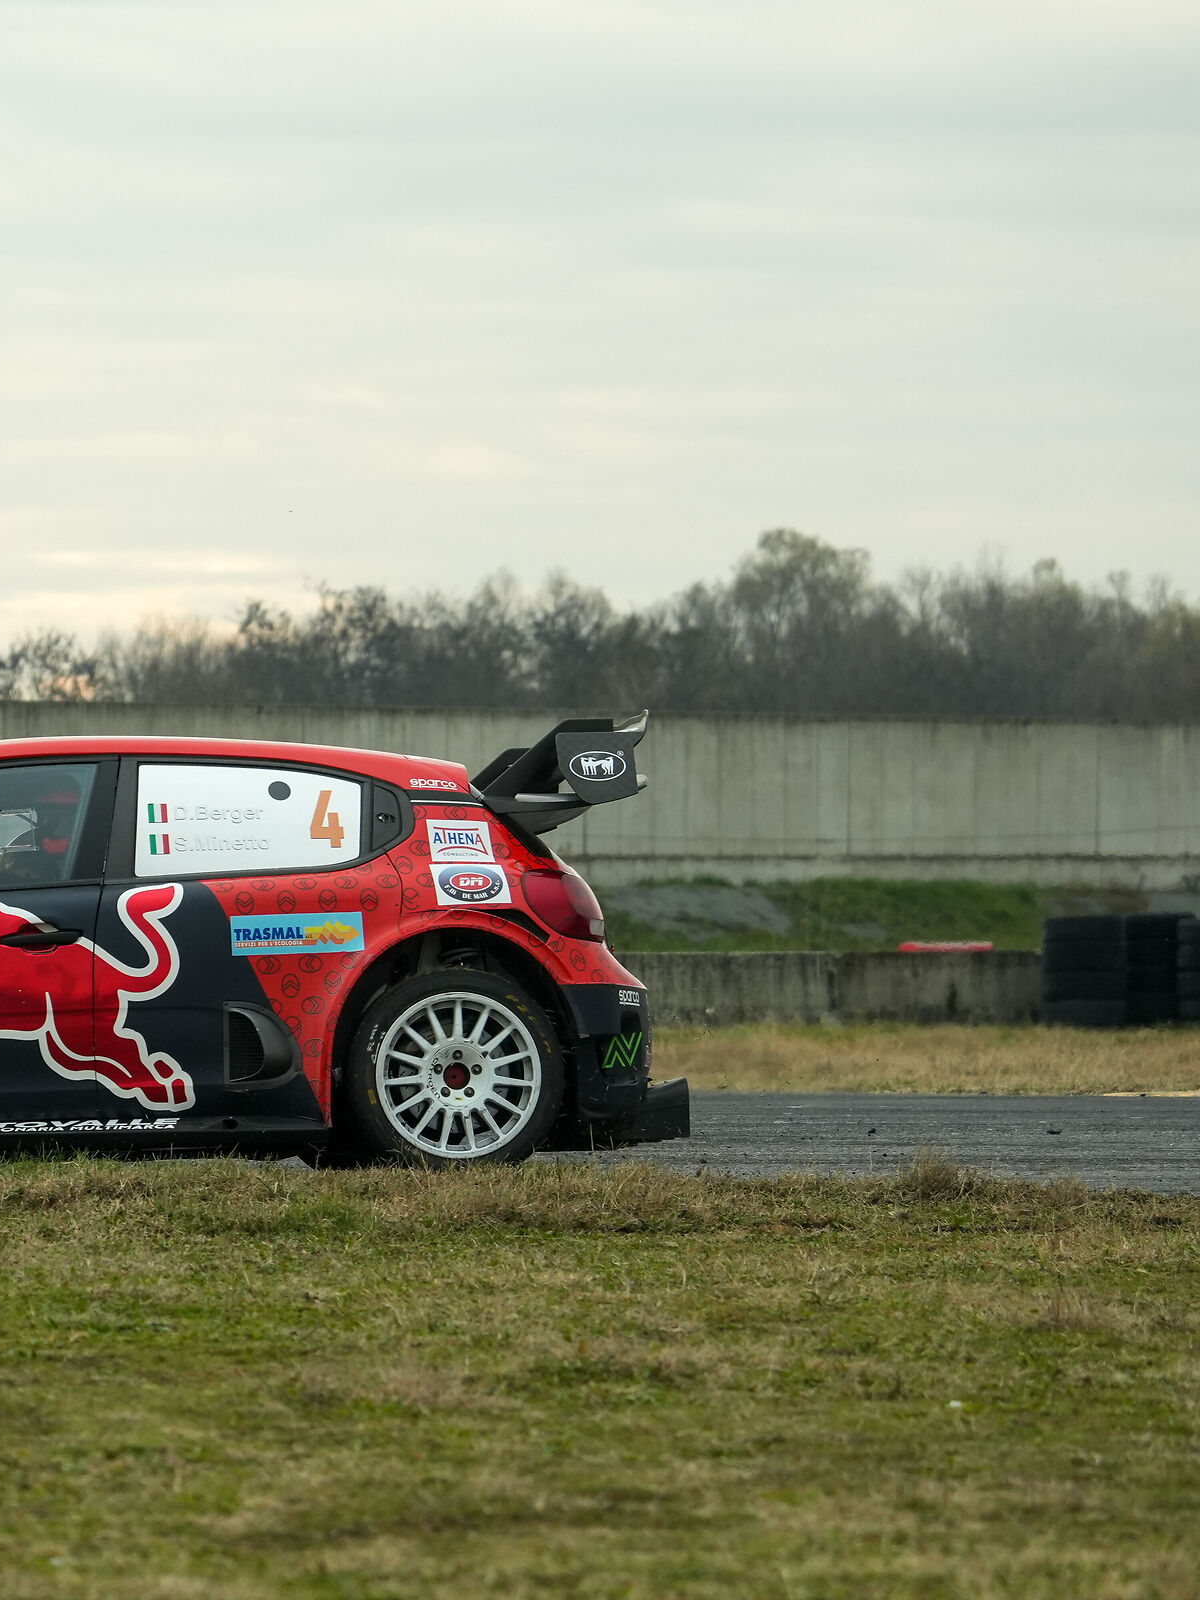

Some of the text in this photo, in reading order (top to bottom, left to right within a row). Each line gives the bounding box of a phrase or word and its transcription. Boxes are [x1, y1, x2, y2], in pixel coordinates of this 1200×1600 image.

[409, 778, 457, 790] sparco
[174, 806, 264, 824] D.Berger
[310, 790, 344, 848] 4
[174, 836, 270, 852] S.Minetto
[433, 827, 485, 846] ATHENA
[459, 877, 484, 886] DM
[233, 927, 304, 941] TRASMAL
[618, 990, 640, 1006] sparco
